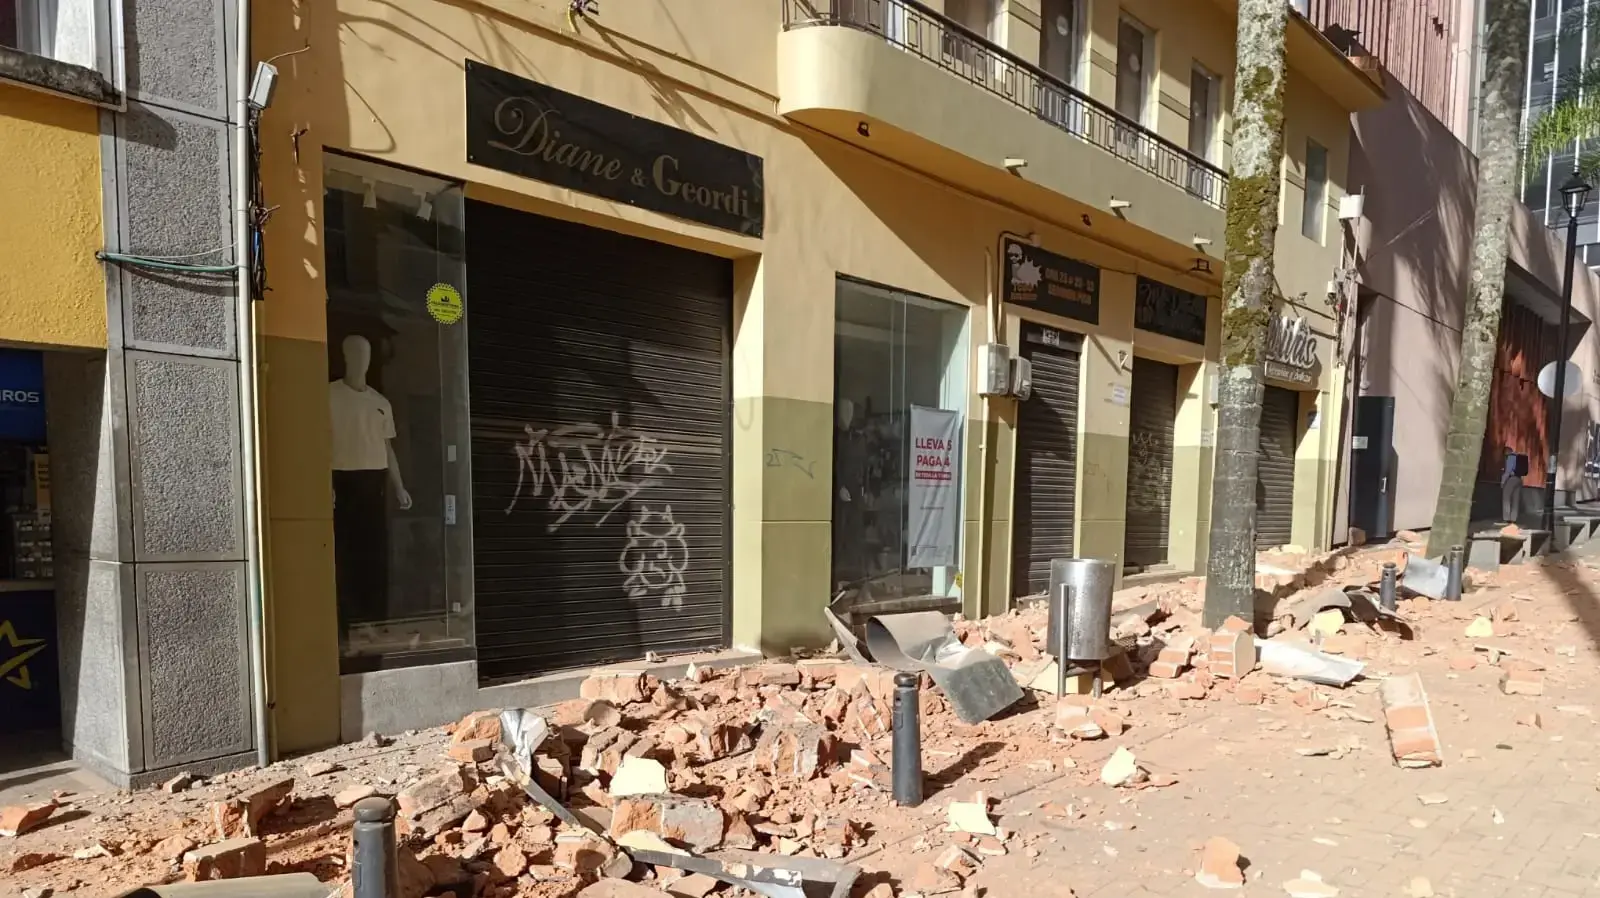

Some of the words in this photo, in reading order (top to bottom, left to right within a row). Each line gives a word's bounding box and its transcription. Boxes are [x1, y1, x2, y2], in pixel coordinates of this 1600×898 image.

[487, 97, 623, 180] Diane
[630, 167, 648, 188] &
[652, 154, 749, 218] Geordi
[915, 437, 945, 450] LLEVA
[916, 454, 943, 467] PAGA
